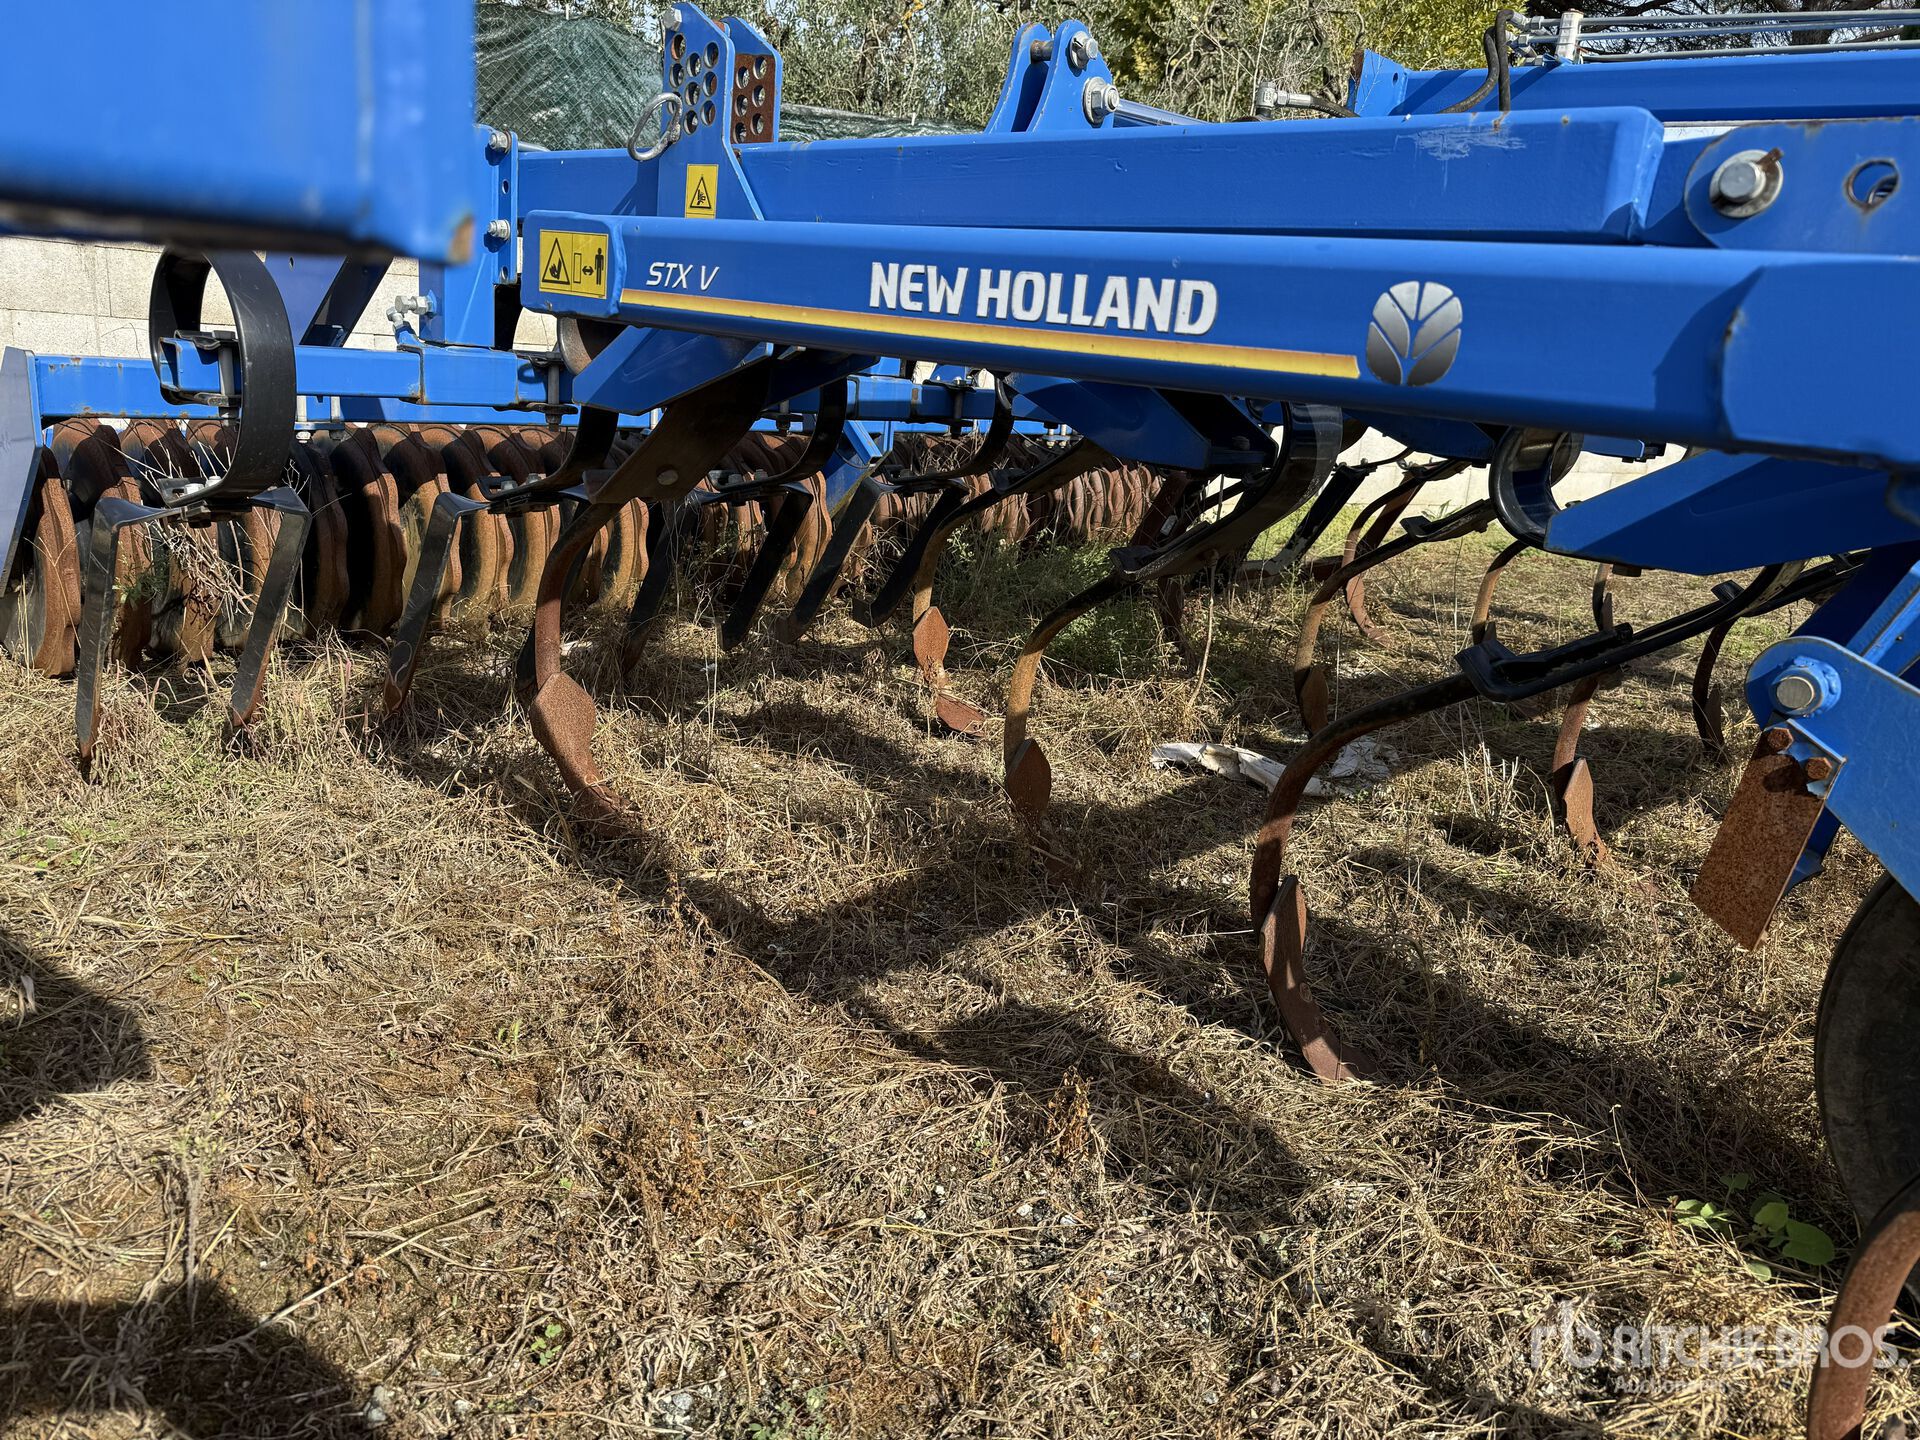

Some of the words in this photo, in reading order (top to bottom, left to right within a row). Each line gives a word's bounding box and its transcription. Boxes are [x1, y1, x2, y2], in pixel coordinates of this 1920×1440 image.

[646, 261, 695, 291] STX
[699, 265, 720, 292] V
[869, 261, 970, 316] NEW
[976, 268, 1218, 335] HOLLAND
